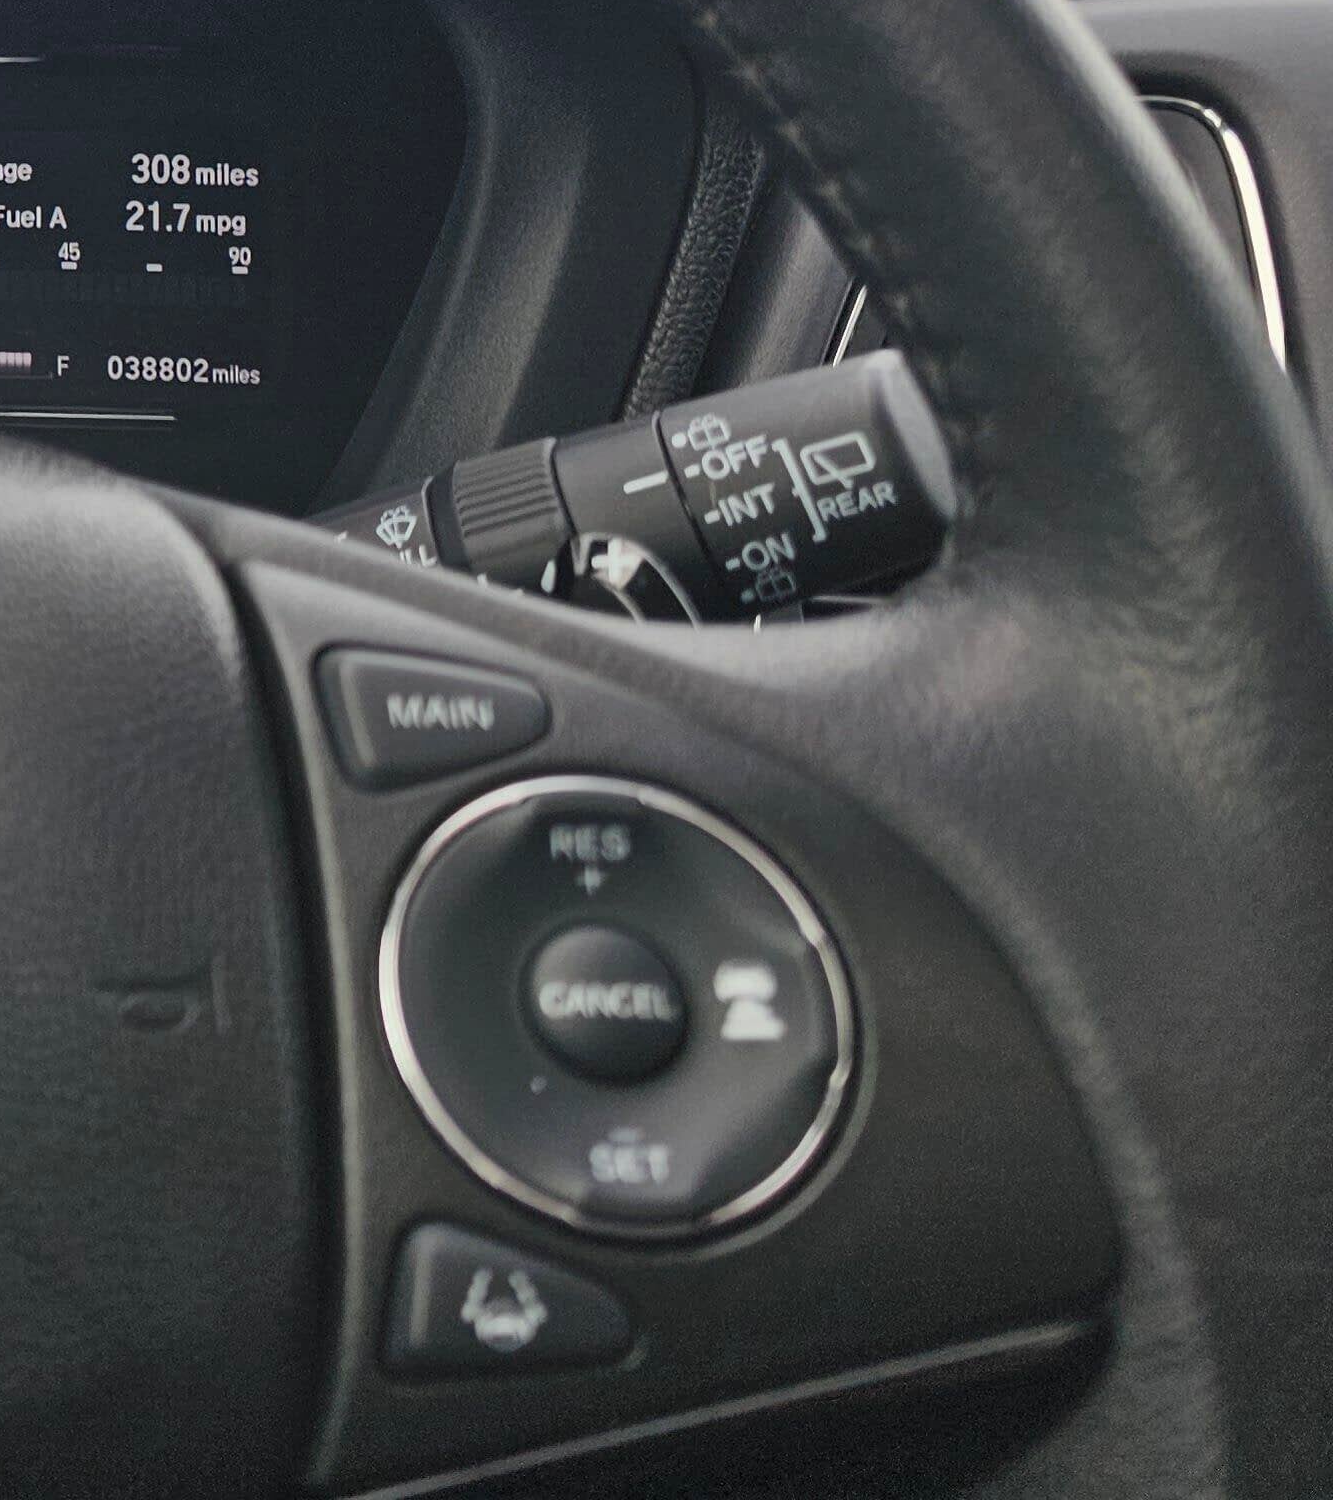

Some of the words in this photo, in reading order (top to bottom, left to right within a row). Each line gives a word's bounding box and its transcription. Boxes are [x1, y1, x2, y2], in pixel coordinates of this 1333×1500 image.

[131, 153, 191, 185] 308
[195, 162, 259, 187] miles
[49, 206, 68, 230] A
[125, 200, 191, 233] 21.7
[195, 214, 246, 237] mpg
[58, 241, 81, 261] 45
[228, 246, 252, 265] 90
[57, 355, 70, 377] F
[702, 436, 770, 480] OFF
[719, 484, 777, 526] INT
[817, 481, 899, 524] REAR
[741, 534, 796, 572] ON
[387, 693, 495, 732] MAIN
[549, 824, 630, 862] RES
[539, 982, 675, 1021] CANCEL
[588, 1143, 672, 1183] SET
